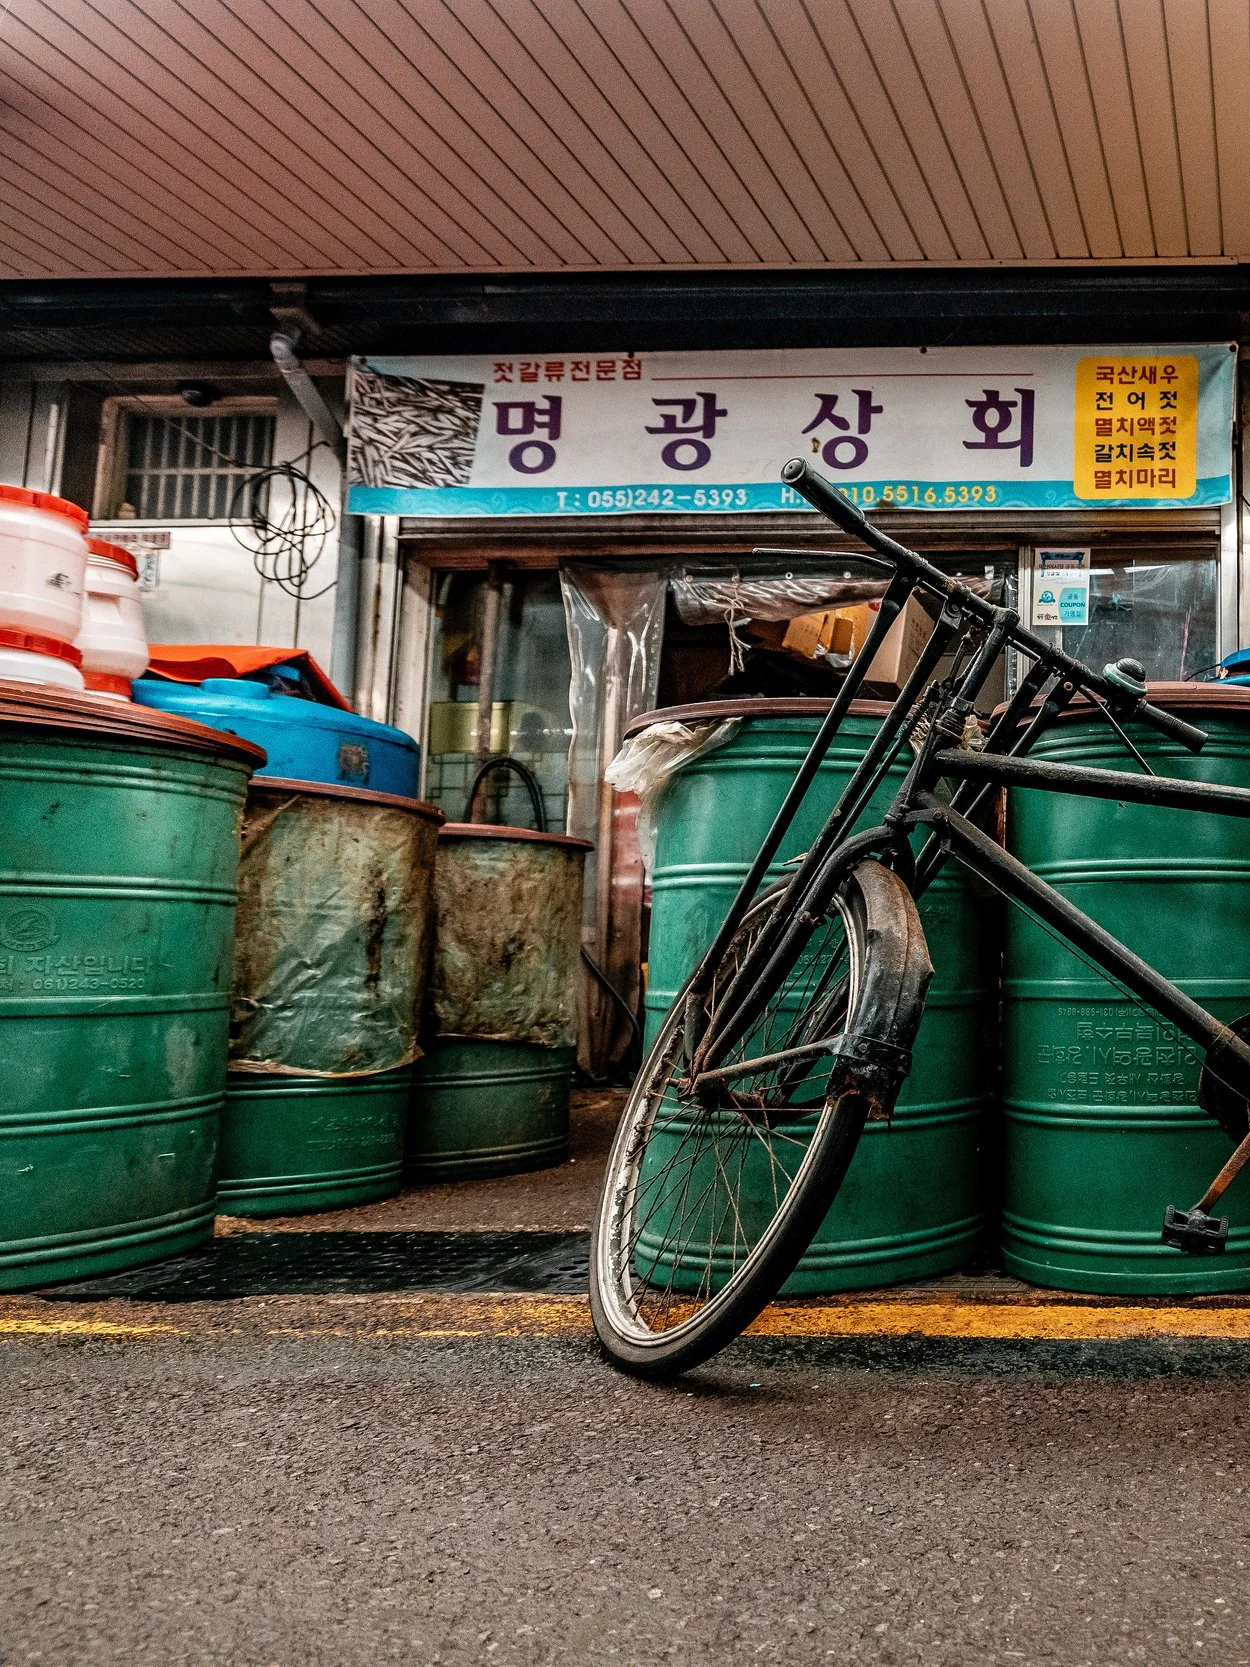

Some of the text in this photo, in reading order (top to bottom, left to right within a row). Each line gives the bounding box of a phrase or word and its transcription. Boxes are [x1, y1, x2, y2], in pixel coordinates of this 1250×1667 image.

[492, 359, 643, 383] 젓갈류전문점
[1095, 364, 1179, 386] 국산새우
[1094, 415, 1178, 437] 멸치액젓
[1094, 441, 1177, 463] 갈치속젓
[1093, 467, 1177, 490] 멸치마리
[587, 488, 748, 508] 055)242-5393
[27, 955, 153, 976] 자산입니다
